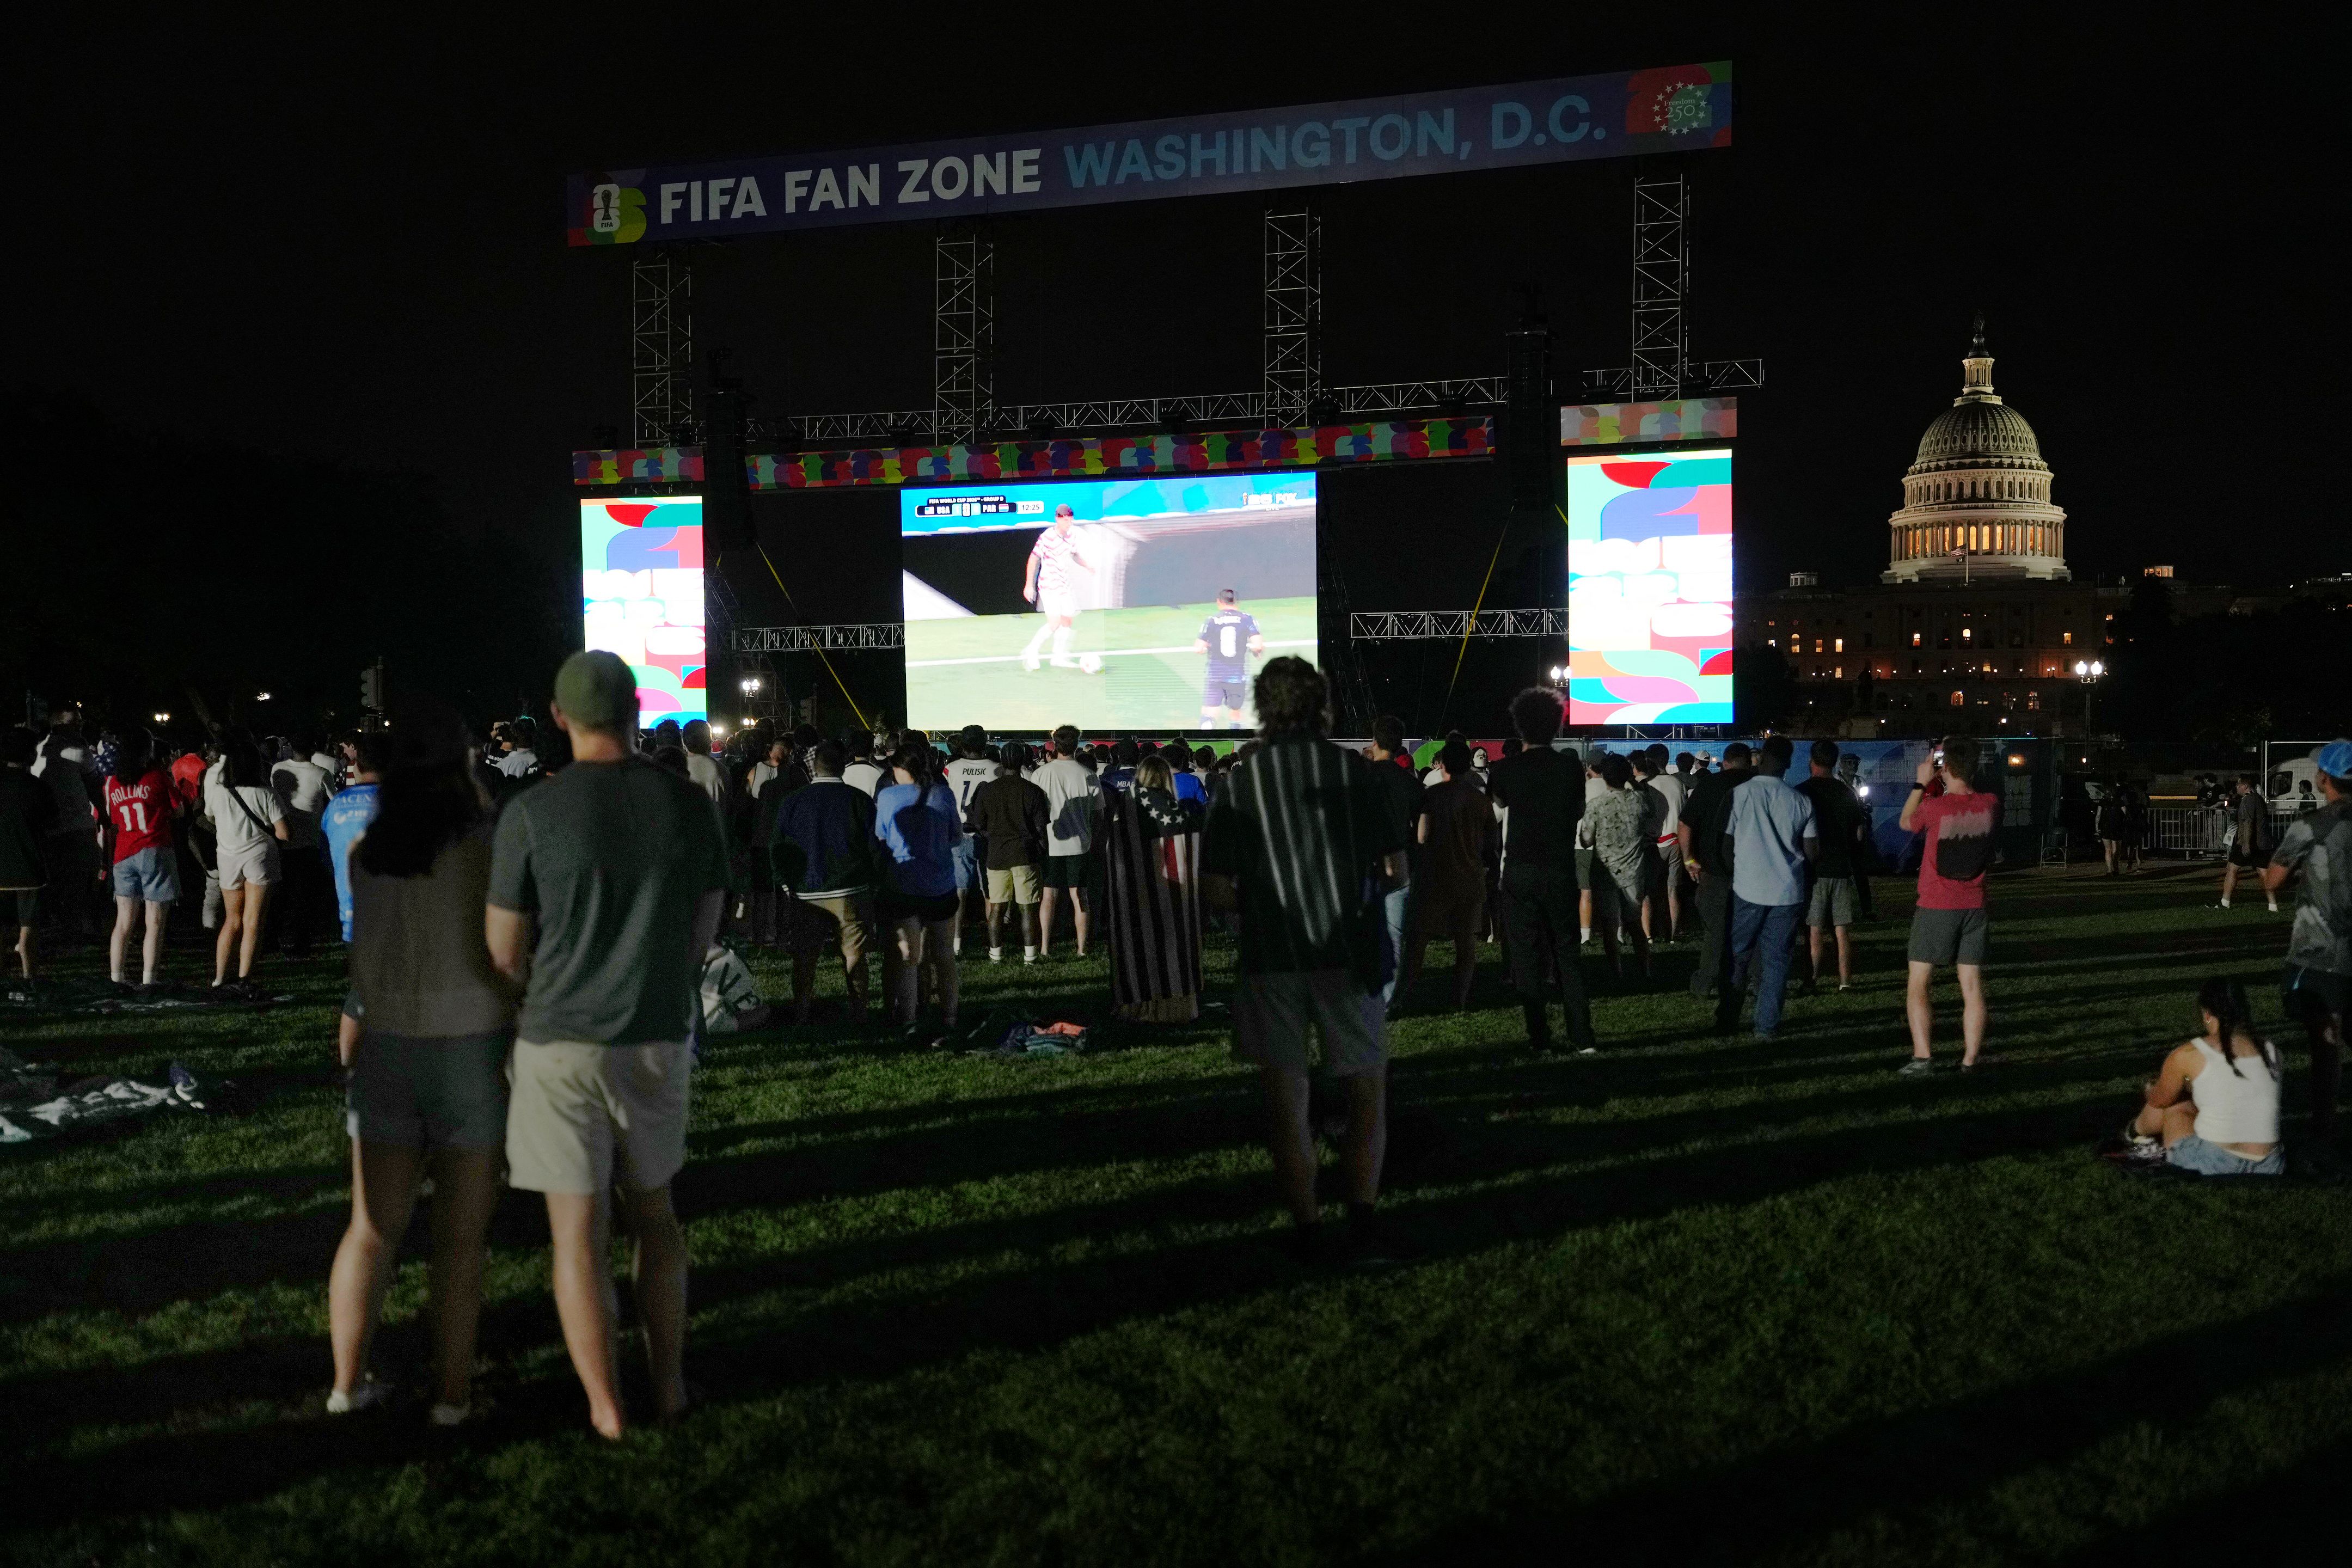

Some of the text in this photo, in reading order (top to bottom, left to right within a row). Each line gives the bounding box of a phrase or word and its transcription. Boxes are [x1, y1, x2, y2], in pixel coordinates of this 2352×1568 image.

[1664, 106, 1695, 122] 250
[660, 94, 1606, 224] FIFA FAN ZONE WASHINGTON, D.C.
[111, 784, 151, 806] ROLLINS
[119, 802, 148, 834] 11
